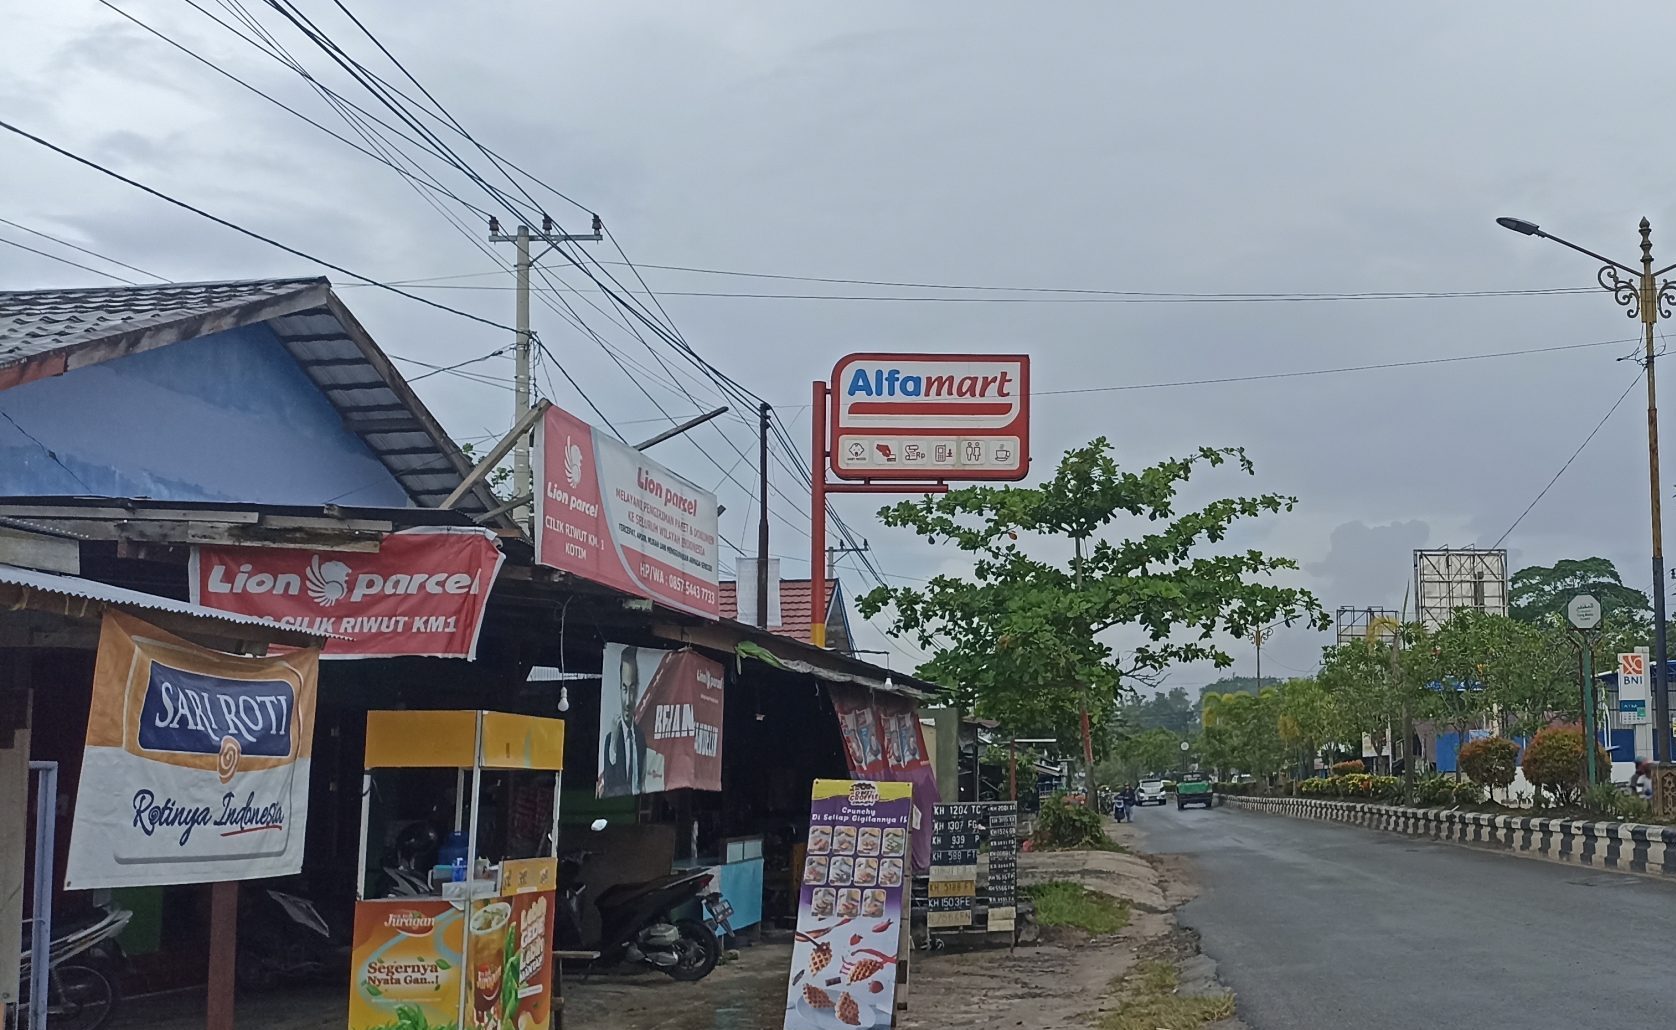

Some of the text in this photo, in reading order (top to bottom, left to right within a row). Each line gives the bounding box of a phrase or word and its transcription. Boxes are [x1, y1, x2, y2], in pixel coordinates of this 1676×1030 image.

[848, 368, 1013, 398] Alfamart
[547, 482, 598, 518] Lion parcel
[637, 467, 697, 517] Lion parcel
[545, 515, 564, 533] CILIK
[566, 524, 587, 542] RIWUT
[565, 543, 586, 560] KOTIM
[208, 563, 482, 602] Lion parcel
[668, 574, 684, 591] 0857
[685, 581, 700, 598] 5443
[701, 587, 715, 605] 7733
[339, 615, 409, 633] RIWUT
[411, 615, 457, 633] KM1
[1624, 677, 1643, 685] BNI
[155, 681, 288, 743] SARI ROTI
[132, 788, 285, 847] Rotinya Indonesia
[841, 806, 876, 816] Crunchy
[933, 805, 981, 815] KH 1204 TC
[934, 822, 944, 831] KH
[932, 835, 980, 845] KH 939 P
[932, 851, 942, 861] KH
[928, 898, 939, 907] KH
[384, 913, 436, 930] Juragan
[367, 962, 439, 978] Segernya
[366, 974, 440, 987] Nyata Gan..!
